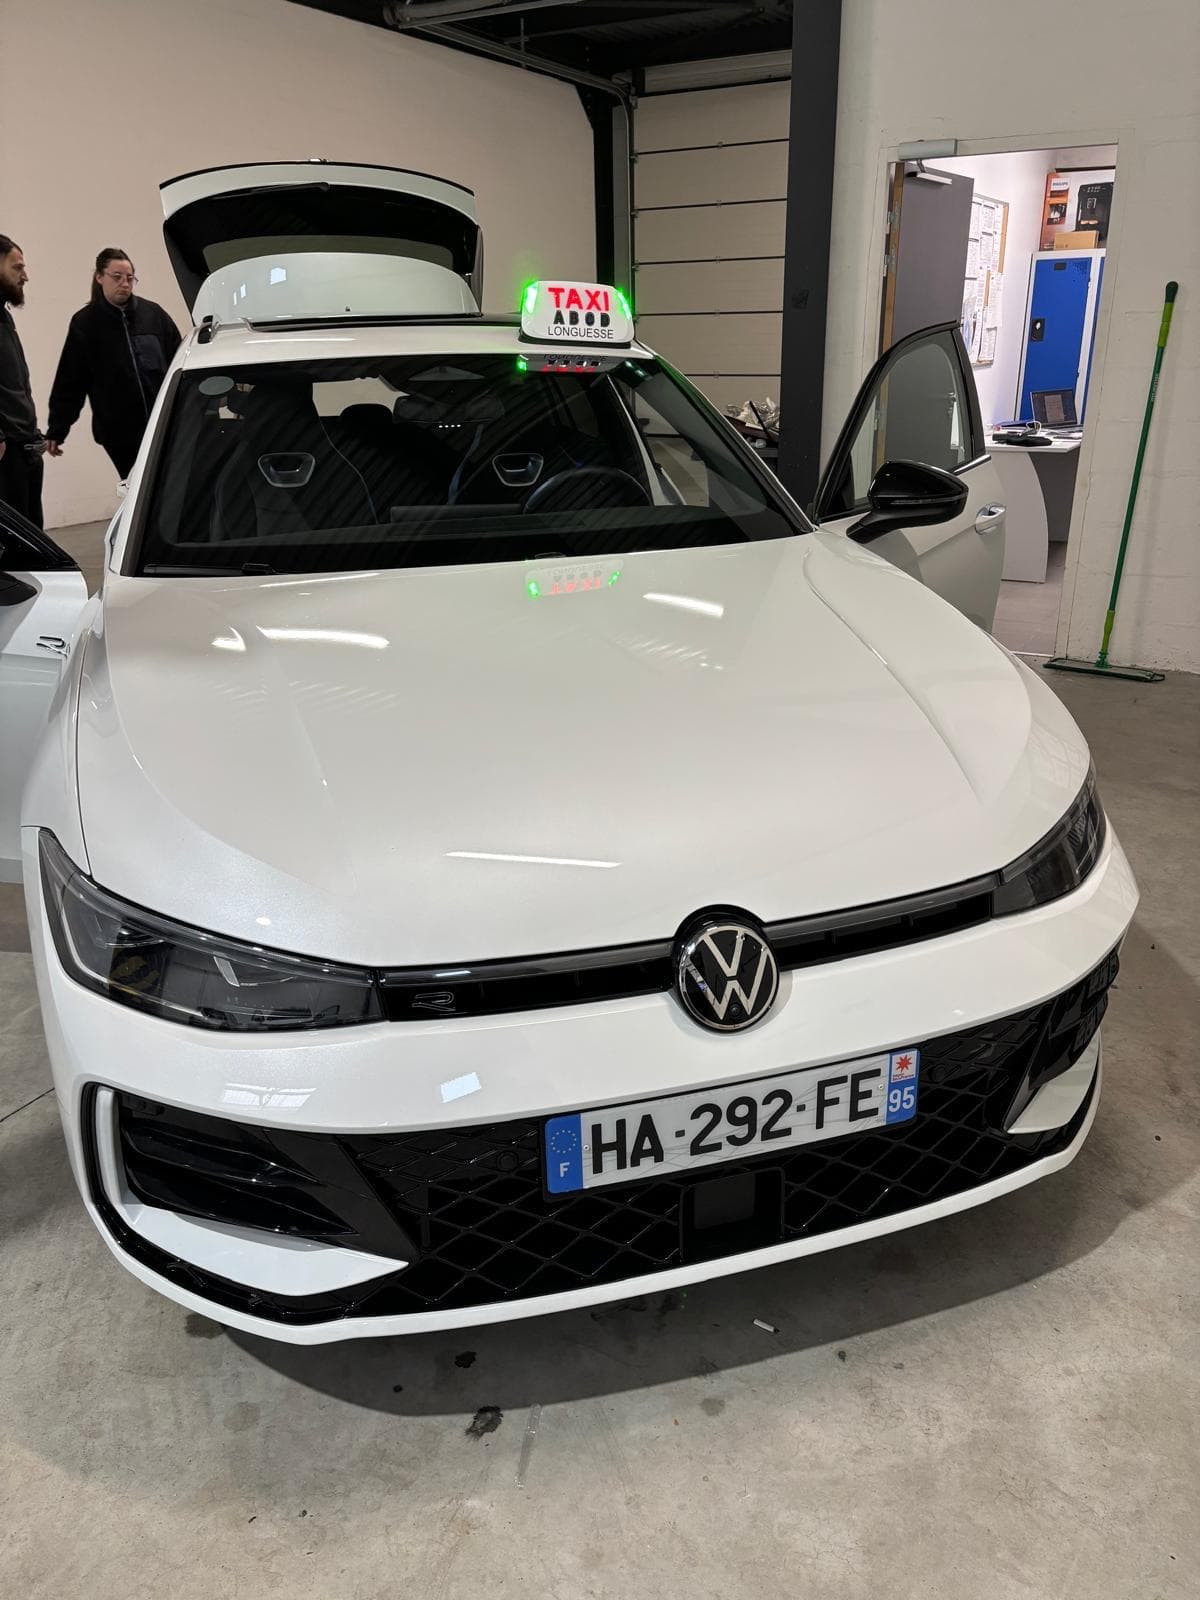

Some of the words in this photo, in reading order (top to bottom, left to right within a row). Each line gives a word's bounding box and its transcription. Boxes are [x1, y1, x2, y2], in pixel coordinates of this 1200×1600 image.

[548, 287, 610, 312] TAXI
[553, 310, 610, 328] ABOD
[547, 326, 614, 339] LONGUESSE
[681, 927, 770, 1020] VW
[888, 1085, 915, 1114] 95
[591, 1067, 882, 1175] HA-292-FE
[559, 1162, 569, 1178] F
